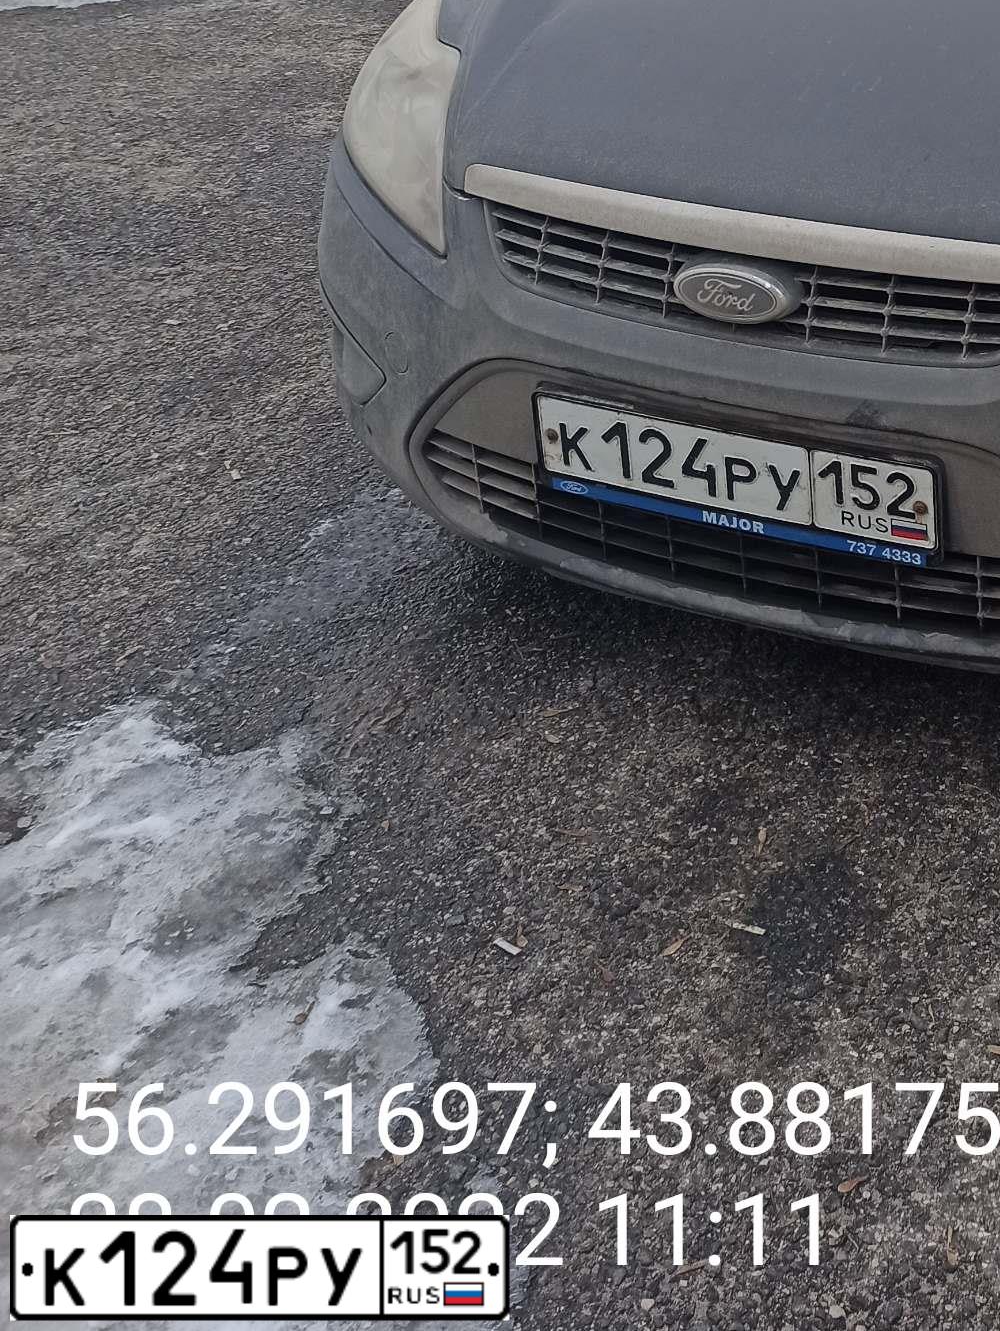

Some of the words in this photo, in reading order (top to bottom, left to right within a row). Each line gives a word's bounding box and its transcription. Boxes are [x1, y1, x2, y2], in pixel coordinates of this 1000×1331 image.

[697, 278, 757, 312] Ford
[558, 421, 801, 511] К124РУ
[818, 460, 917, 520] 152
[702, 510, 765, 534] MAJOR
[841, 510, 889, 533] RUS
[846, 539, 877, 556] 737
[882, 547, 922, 566] 4333
